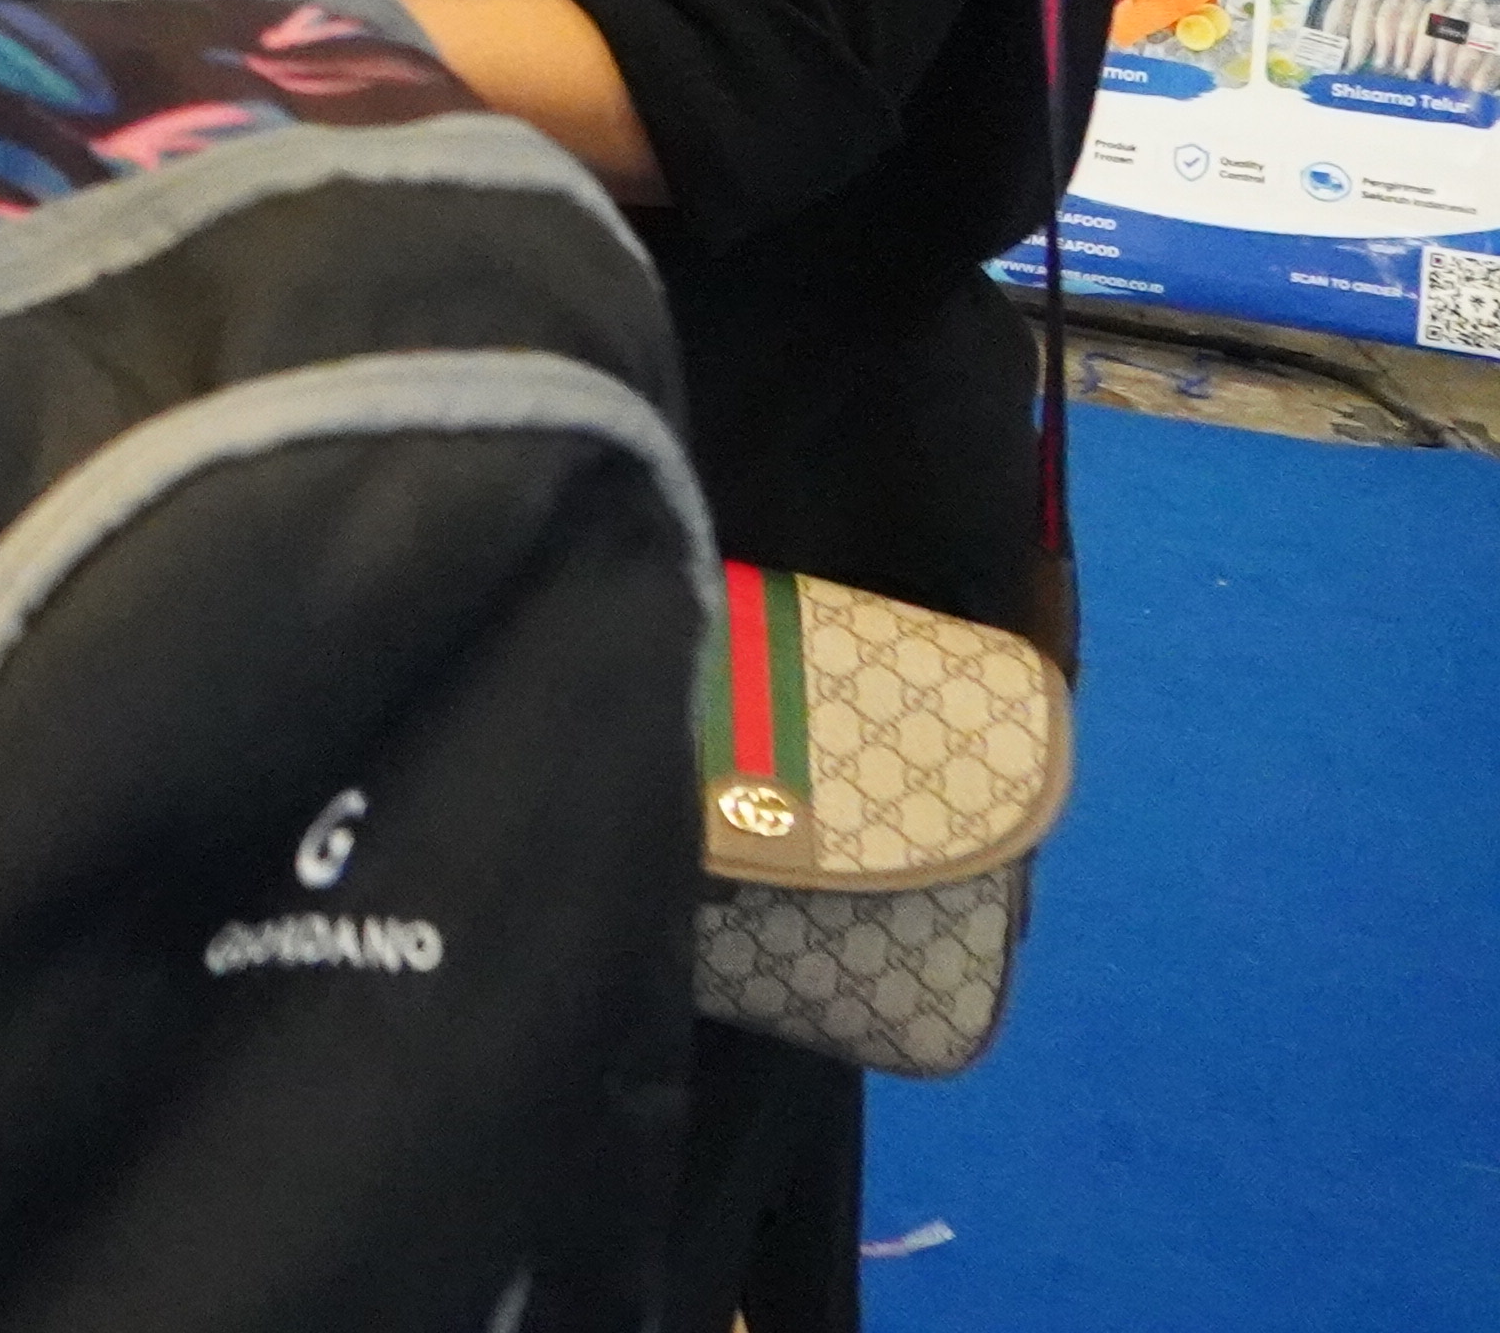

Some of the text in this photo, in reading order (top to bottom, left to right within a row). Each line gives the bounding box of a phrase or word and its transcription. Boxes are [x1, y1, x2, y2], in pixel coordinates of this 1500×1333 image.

[1102, 65, 1148, 83] mon
[1331, 82, 1472, 115] Shisamo Telur
[1095, 139, 1137, 153] Produk
[1095, 152, 1134, 165] Frozen
[1220, 157, 1264, 172] Quality
[1219, 169, 1265, 184] Control
[1056, 210, 1117, 231] EAFOOD
[1290, 271, 1329, 288] SCAN
[1331, 277, 1351, 291] TO
